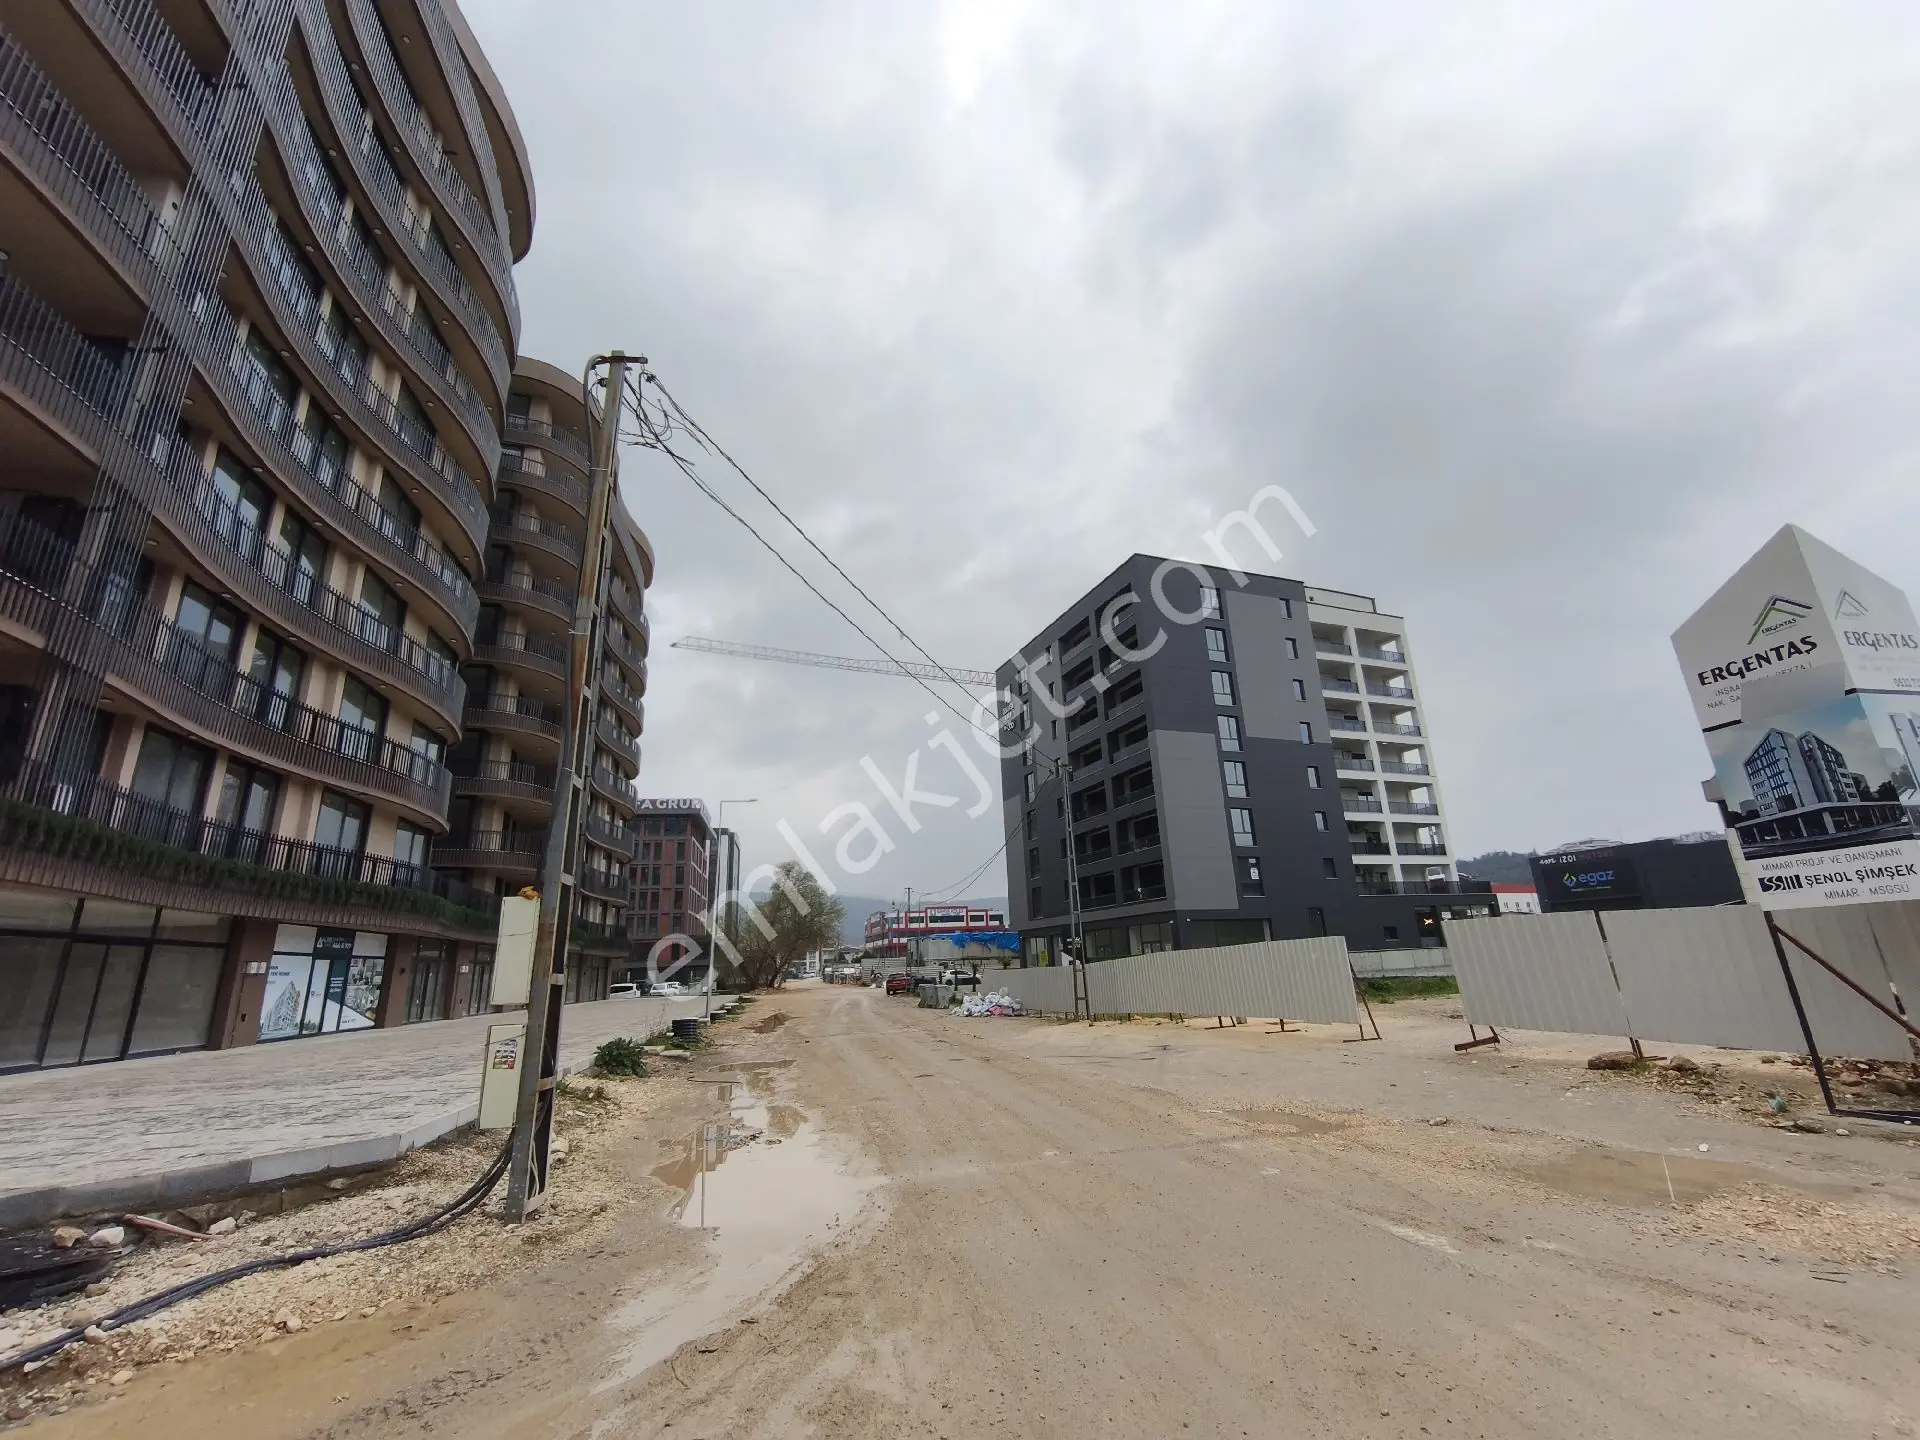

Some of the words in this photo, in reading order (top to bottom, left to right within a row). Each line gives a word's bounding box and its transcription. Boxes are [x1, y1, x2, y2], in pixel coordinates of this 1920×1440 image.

[1697, 635, 1818, 686] ERGENTAŞ
[1828, 855, 1843, 864] VE
[1578, 870, 1616, 886] egaz
[1804, 871, 1853, 888] ŞENOL
[1855, 862, 1918, 884] ŞİMŞEK
